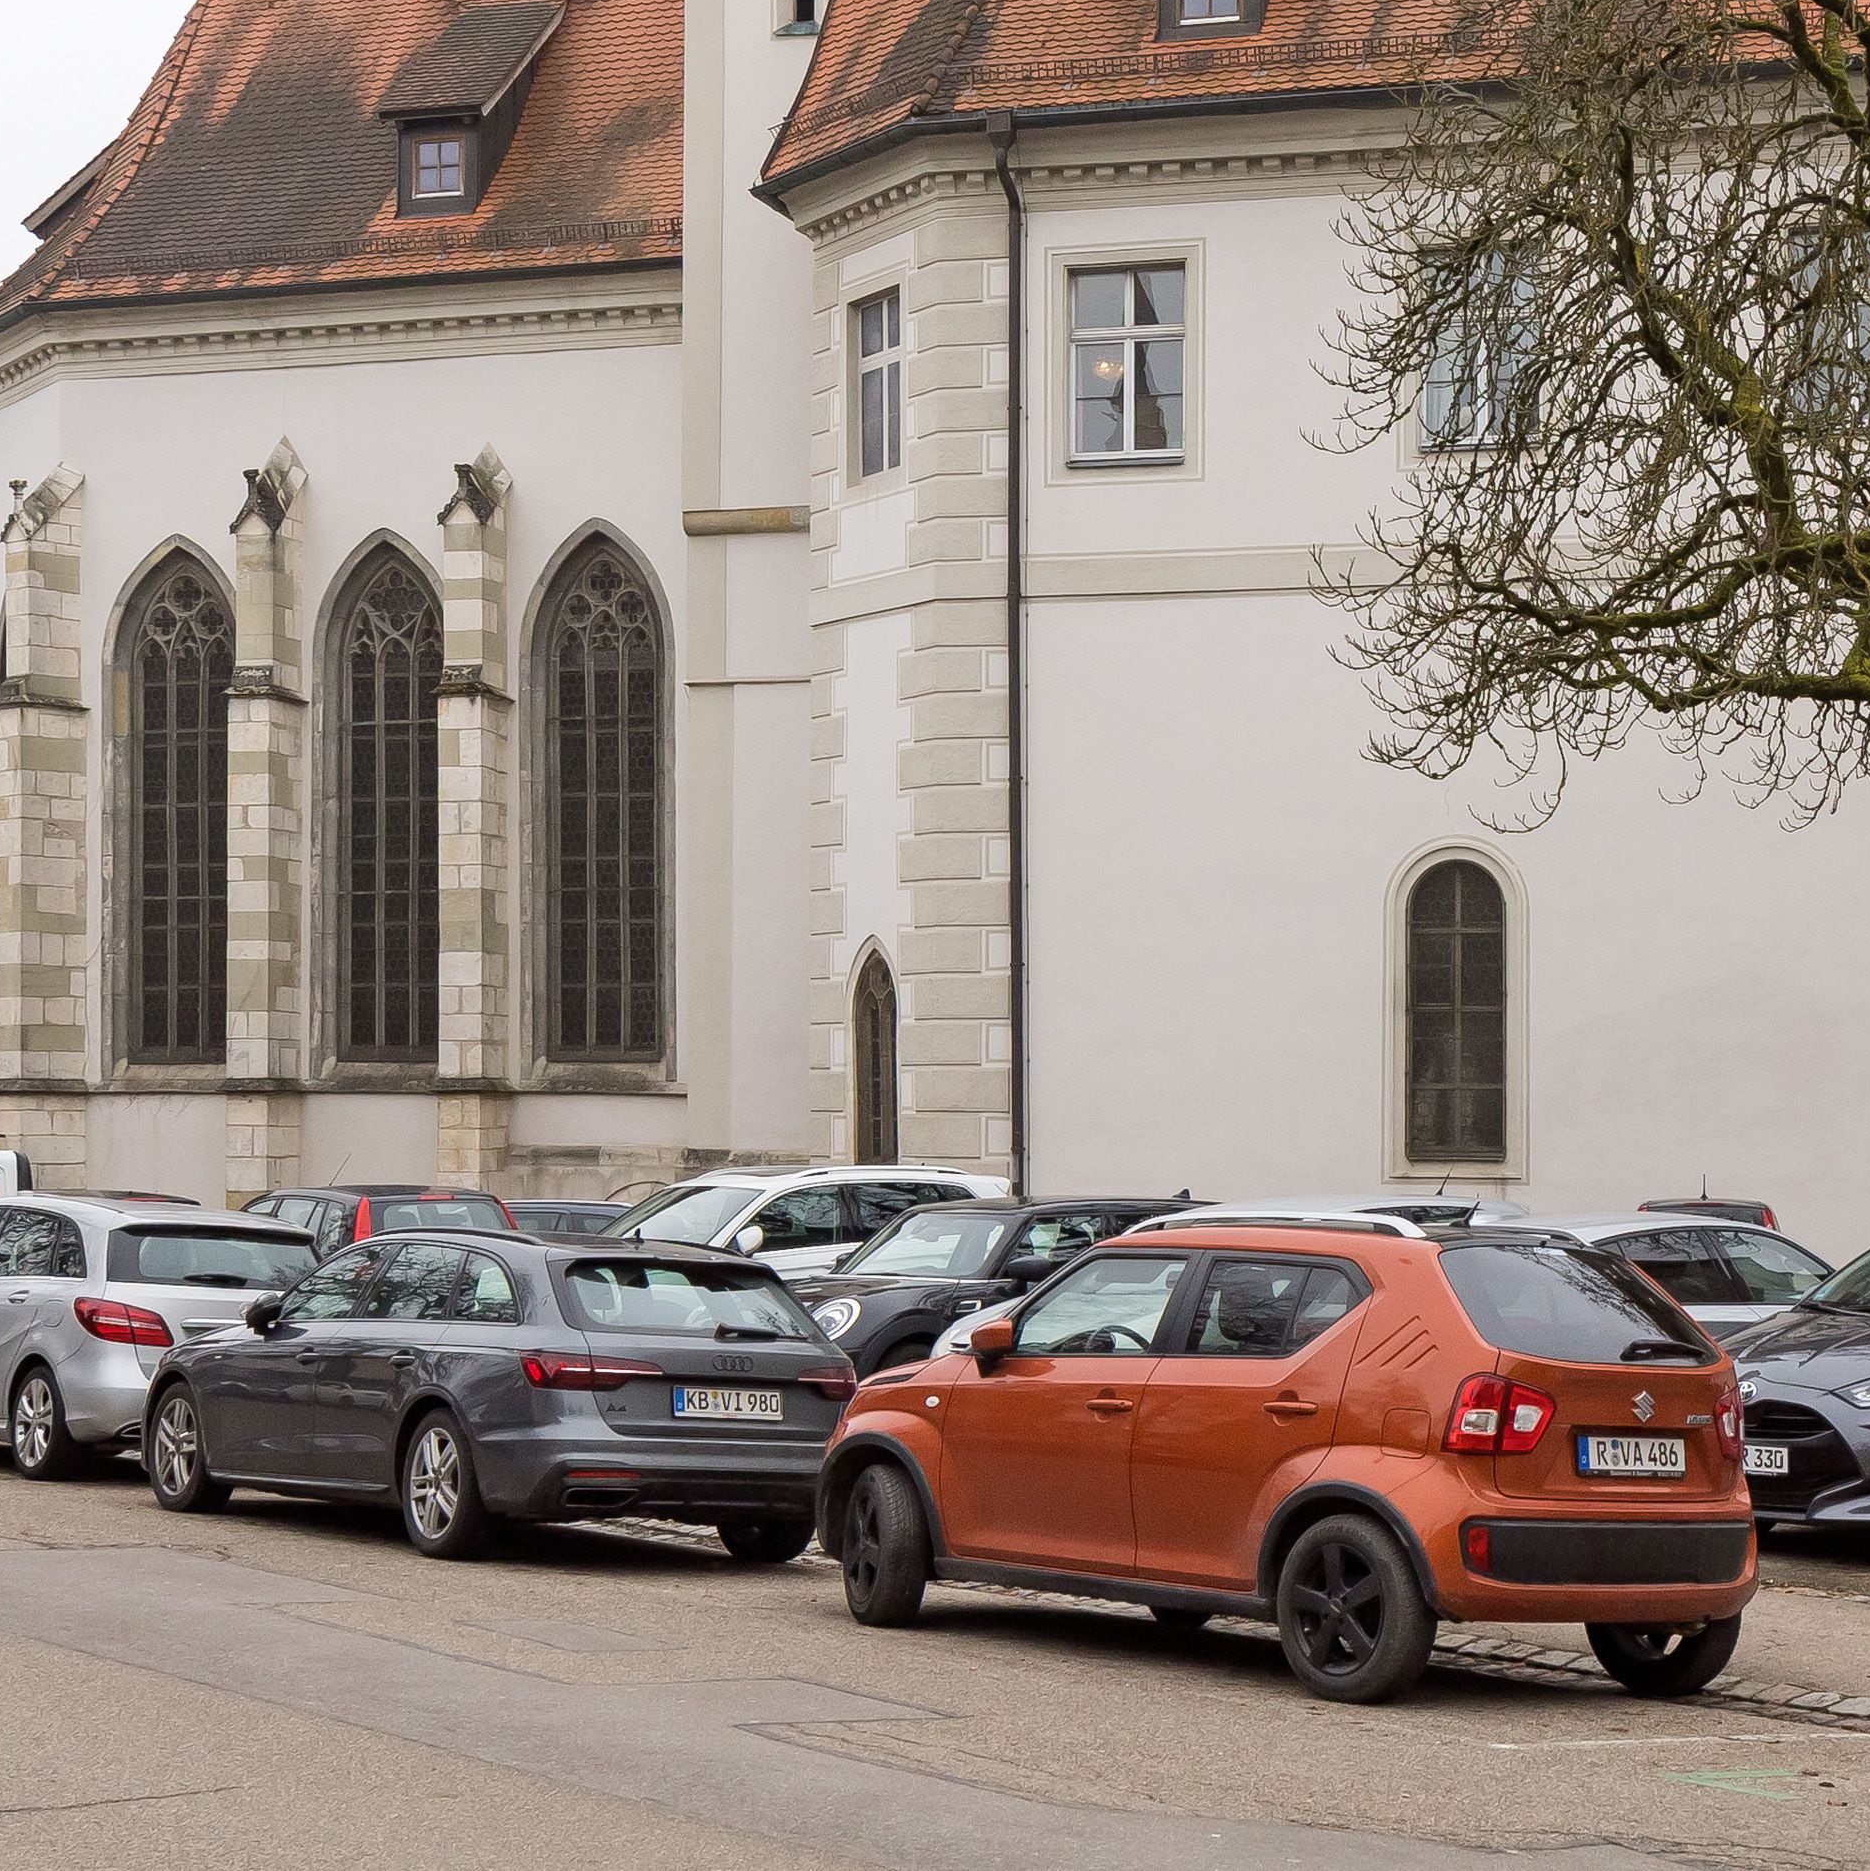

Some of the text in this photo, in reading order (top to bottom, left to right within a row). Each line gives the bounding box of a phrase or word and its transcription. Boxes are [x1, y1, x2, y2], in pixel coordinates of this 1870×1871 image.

[686, 1390, 710, 1410] KB
[720, 1391, 743, 1412] VI
[747, 1393, 779, 1413] 980
[1596, 1441, 1609, 1466] R
[1619, 1441, 1644, 1467] VA
[1647, 1442, 1679, 1467] 486
[1754, 1448, 1784, 1469] 330
